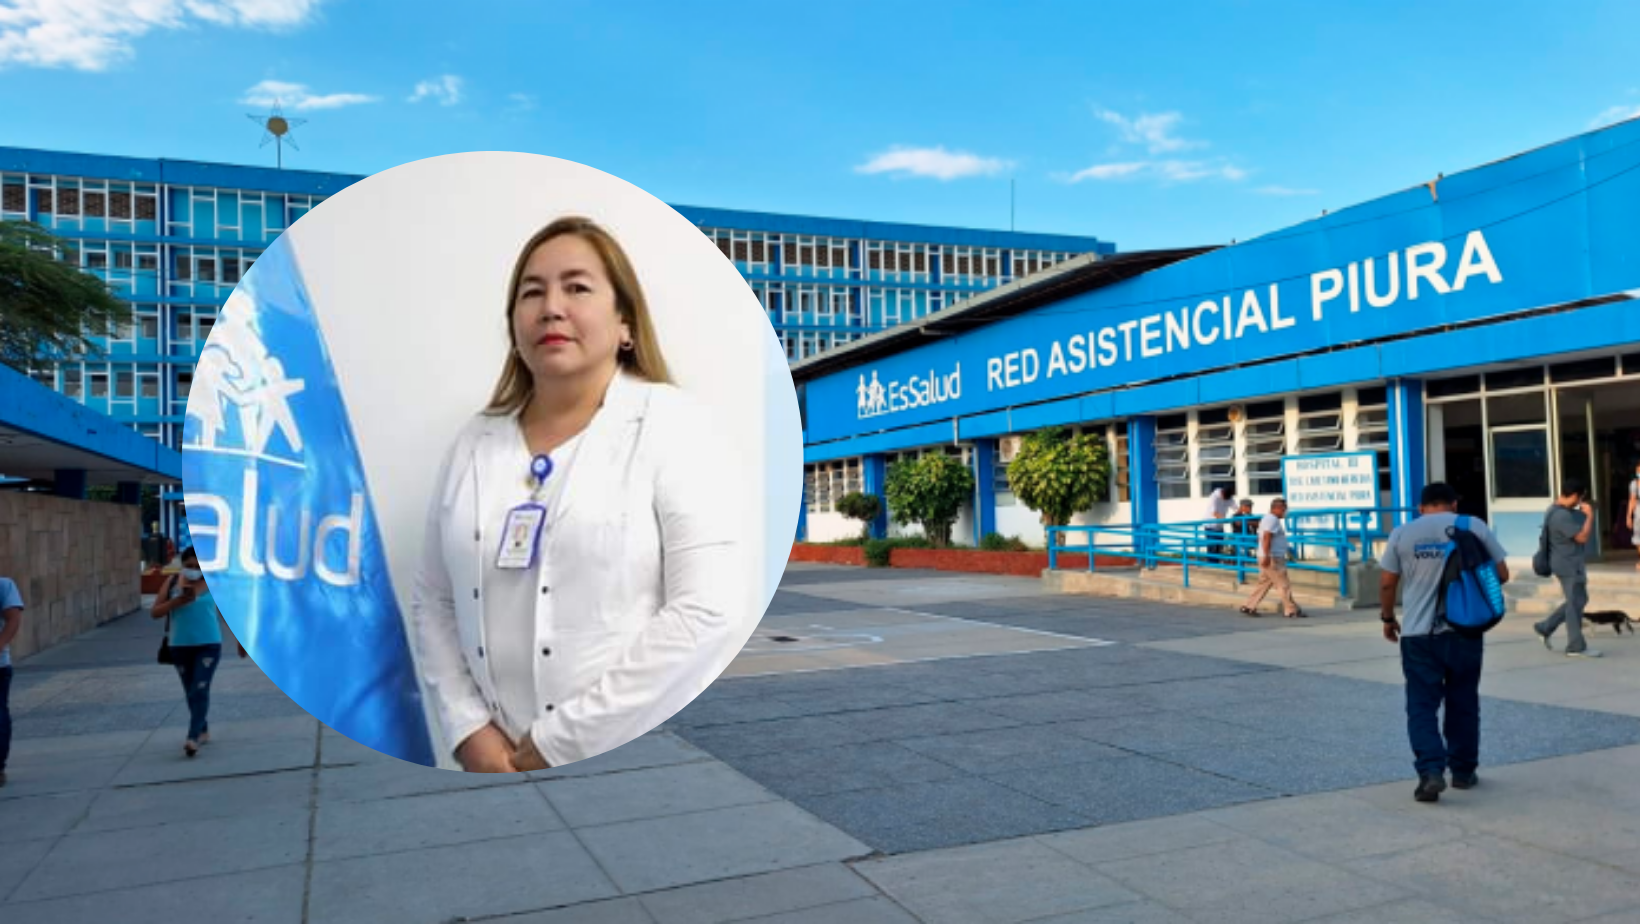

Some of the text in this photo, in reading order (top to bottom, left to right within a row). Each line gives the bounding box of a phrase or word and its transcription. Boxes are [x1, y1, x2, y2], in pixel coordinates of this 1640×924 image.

[987, 230, 1503, 392] RED ASISTENCIAL PIURA
[888, 360, 962, 413] EsSalud
